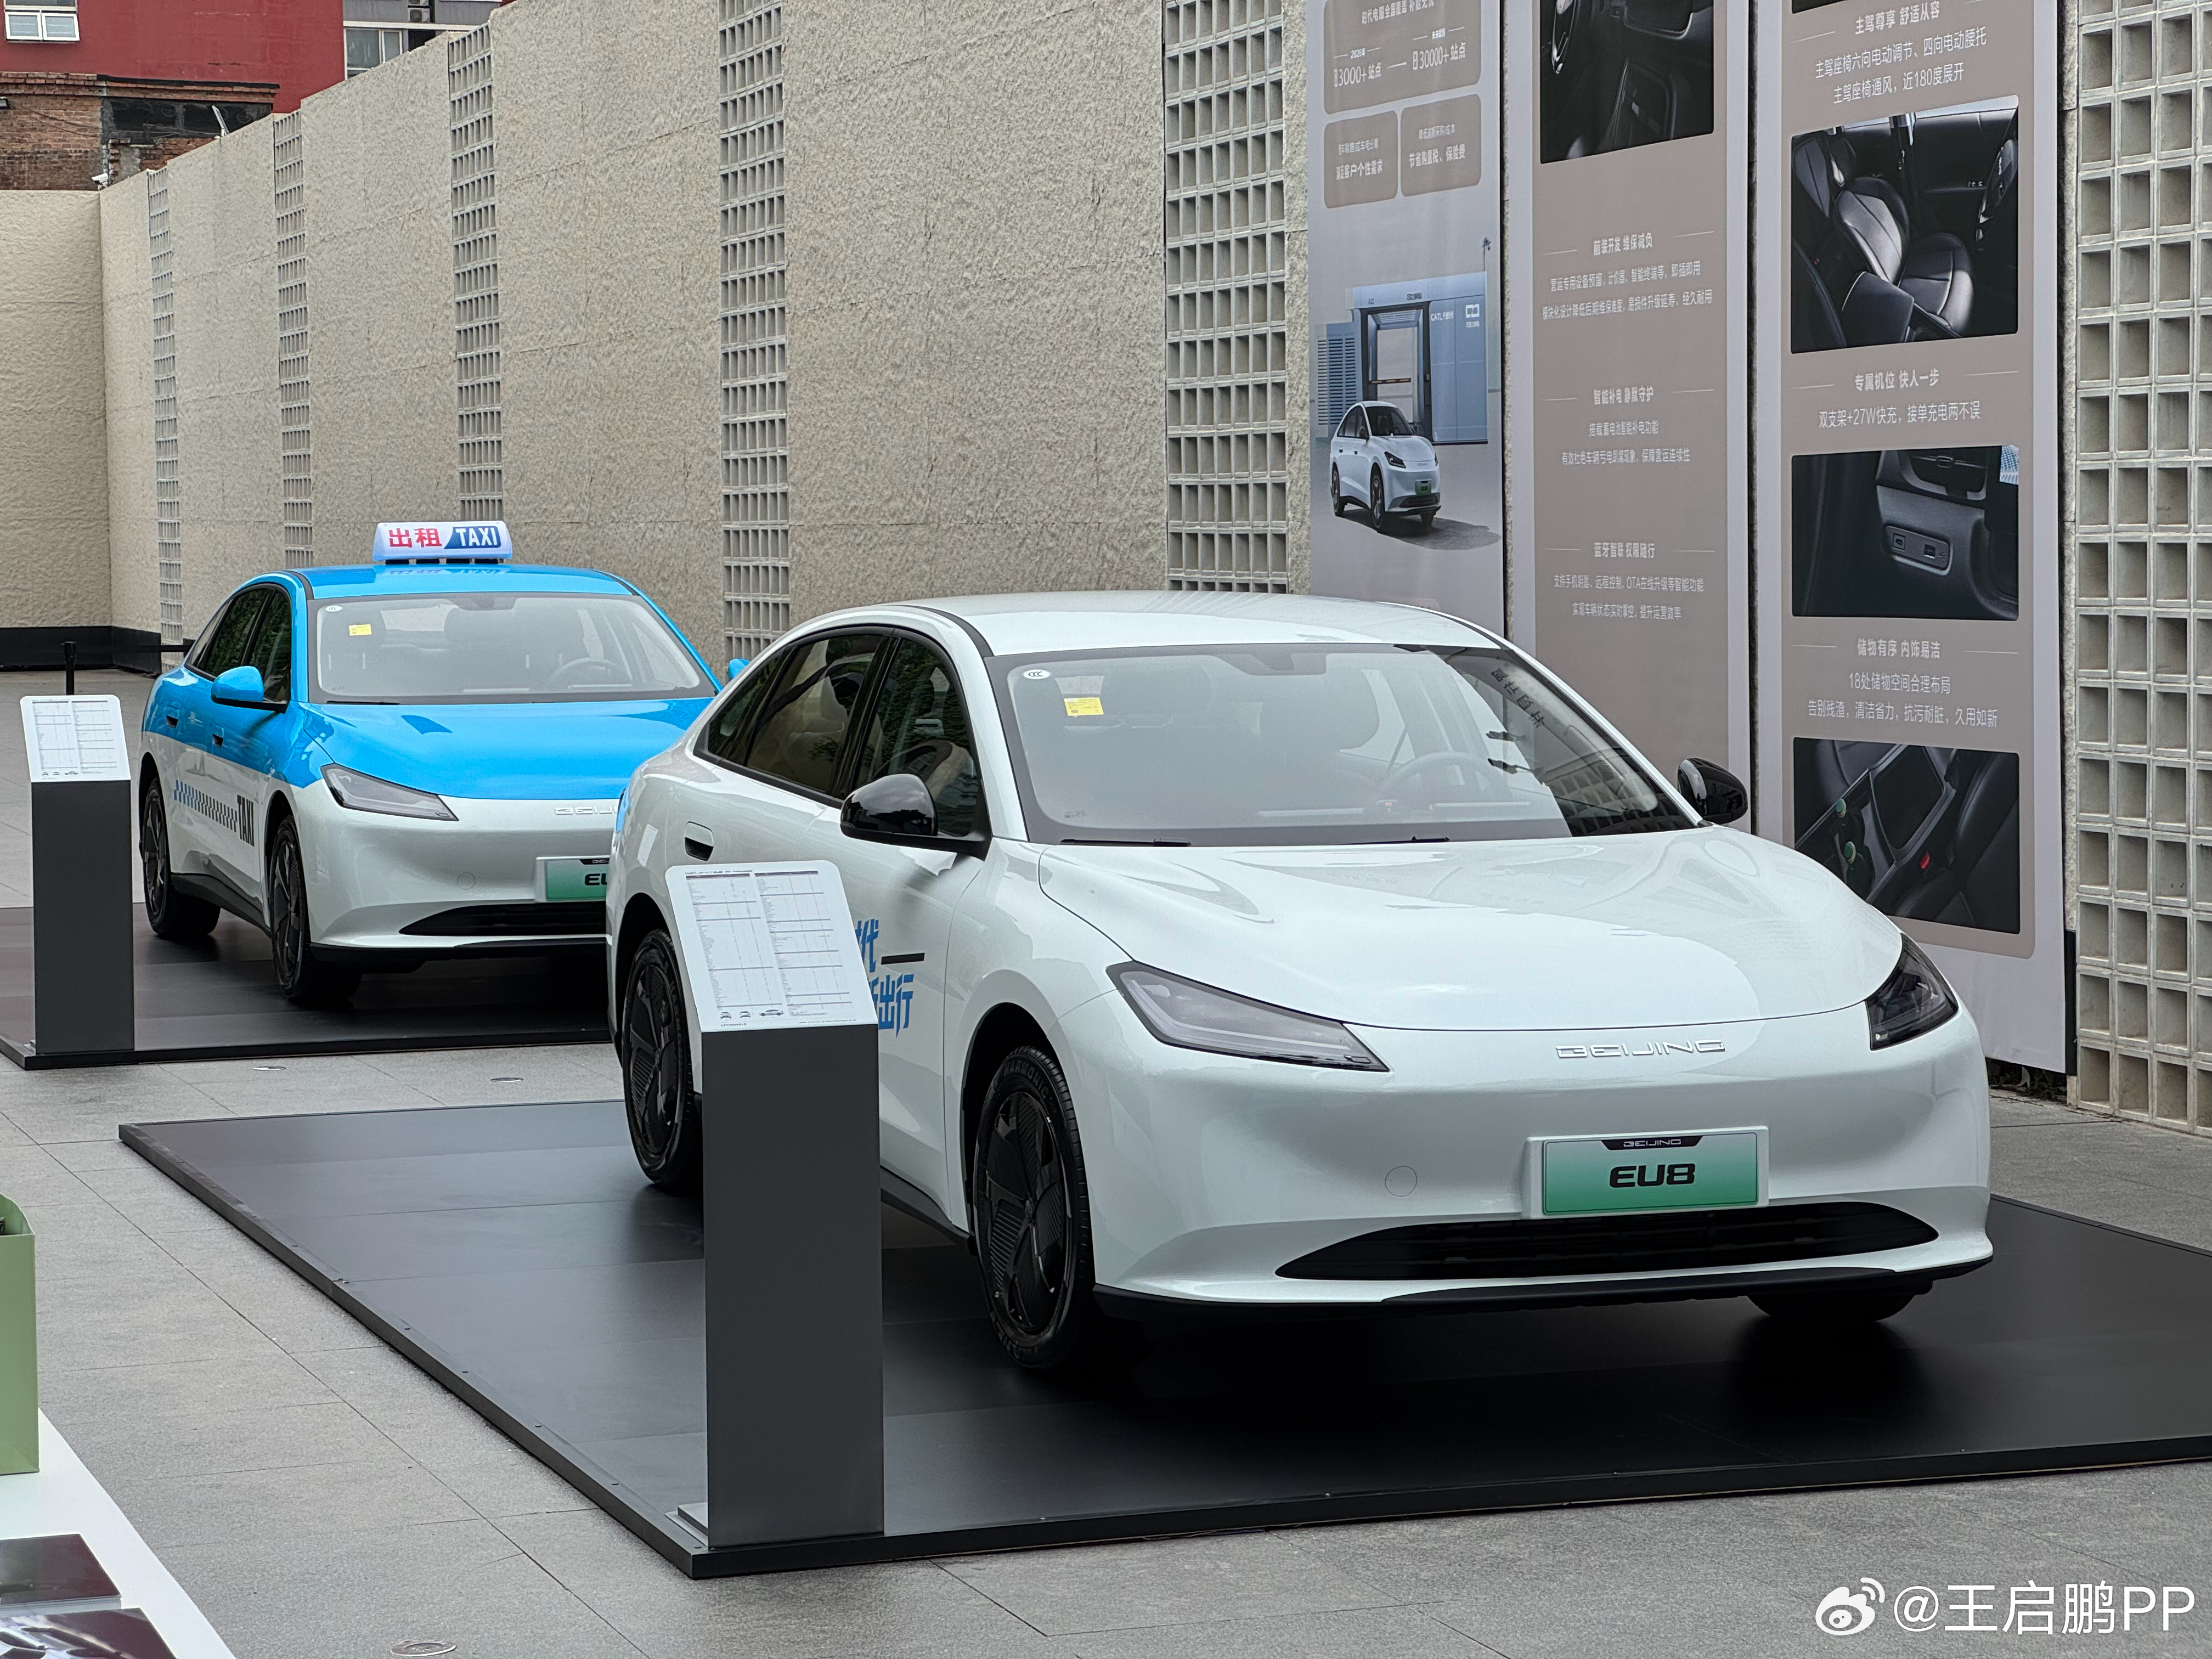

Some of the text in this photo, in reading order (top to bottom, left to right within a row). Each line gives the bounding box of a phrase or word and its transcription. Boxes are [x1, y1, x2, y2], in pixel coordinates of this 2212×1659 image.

[1855, 1, 1940, 35] 主驾尊享 舒适从容
[1451, 42, 1466, 61] 站点
[1815, 26, 1987, 78] 主驾座椅六向电动调节、四向电动腰托
[1368, 61, 1381, 80] 站点
[1832, 62, 1964, 104] 主驾座椅通风，近180度展开
[1409, 144, 1465, 168] 节省购置税、保险费
[1336, 159, 1383, 180] 满足客户个性需求
[1593, 232, 1652, 256] 前装开发 维保减负
[1855, 368, 1939, 391] 专属机位 快人一步
[1594, 386, 1654, 405] 智能补电 静默守护
[1819, 400, 1980, 428] 双支架+27W快充，接单充电两不误
[388, 527, 498, 548] 出租 TAXI
[1594, 542, 1655, 558] 蓝牙智联 权限随行
[1858, 638, 1940, 658] 储物有序 内饰易洁
[1849, 672, 1950, 694] 18处储物空间合理布局
[1808, 698, 1997, 728] 告别残渣，清洁省力，抗污耐脏，久用如新
[237, 794, 255, 847] TAXI
[1555, 1040, 1725, 1059] BEIJING
[1003, 1060, 1049, 1099] HARMONIC
[1623, 1139, 1681, 1148] BEIJING
[1609, 1164, 1695, 1188] EU8
